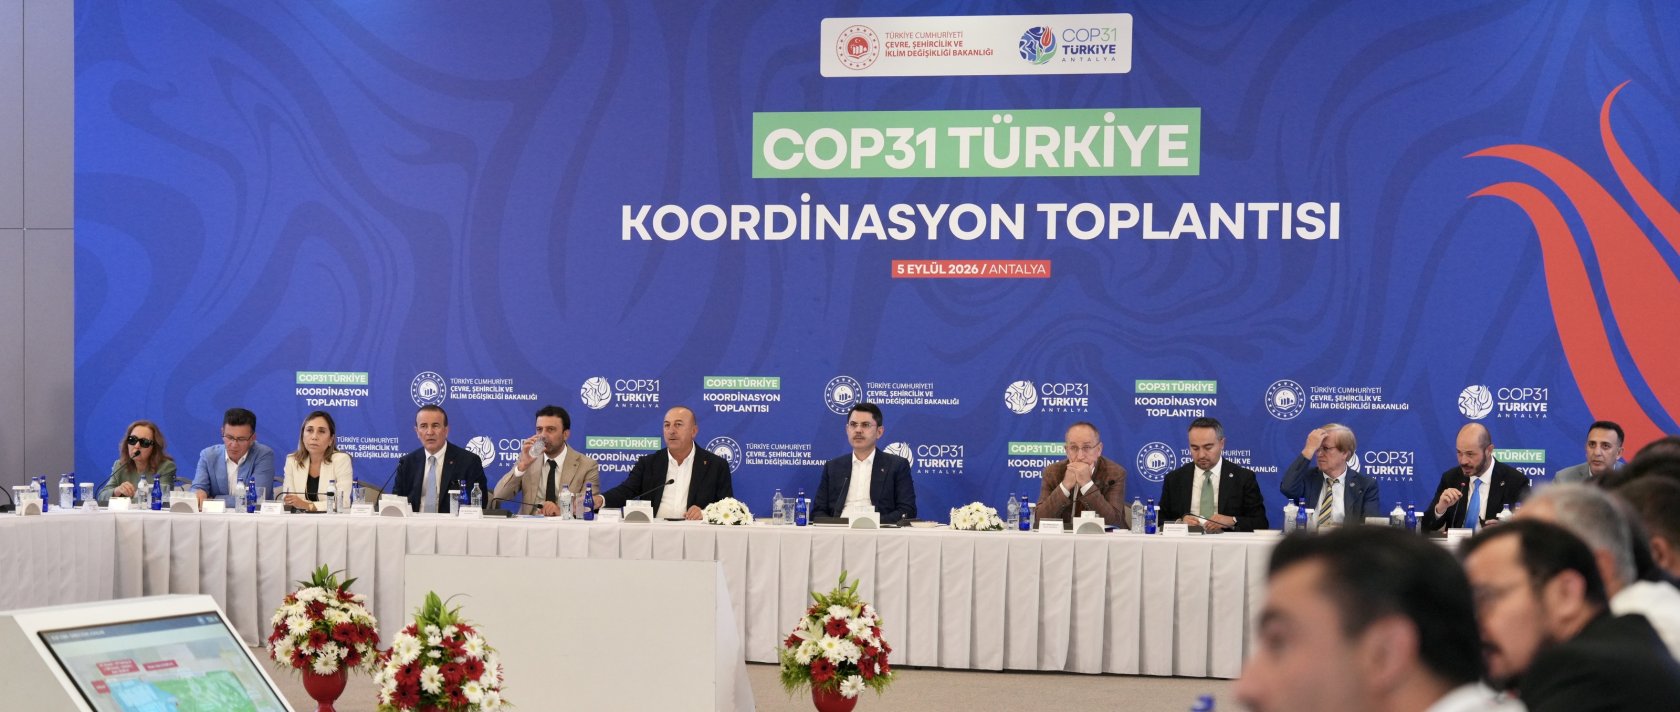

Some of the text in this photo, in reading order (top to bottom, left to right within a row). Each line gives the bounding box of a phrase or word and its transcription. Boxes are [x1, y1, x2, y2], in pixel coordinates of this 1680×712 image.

[885, 31, 913, 39] TÜRKİYE
[1062, 27, 1117, 42] COP31
[912, 40, 952, 49] ŞEHİRCİLİK
[885, 48, 993, 58] İKLİM DEĞİŞİKLİĞİ BAKANLIĞI
[763, 112, 1189, 170] COP31 TÜRKİYE
[622, 192, 1340, 240] KOORDİNASYON TOPLANTISI
[897, 262, 1046, 275] 5 EYLÜL 2026 / ANTALYA
[299, 373, 366, 382] COP31 TÜRKİYE
[706, 377, 778, 387] COP31 TÜRKİYE
[615, 379, 659, 391] COP31
[1041, 383, 1089, 395] COP31
[1171, 381, 1214, 391] TÜRKİYE
[296, 386, 368, 396] KOORDİNASYON
[703, 391, 780, 401] KOORDİNASYON
[1497, 387, 1548, 400] COP31
[1135, 396, 1217, 406] KOORDİNASYON
[1371, 402, 1408, 410] BAKANLIĞI
[714, 404, 769, 412] TOPLANTISI
[1146, 409, 1205, 417] TOPLANTISI
[589, 437, 658, 447] COP31 TÜRKİYE
[917, 445, 963, 457] COP31
[1011, 445, 1043, 453] COP31
[1364, 451, 1414, 464] COP31
[1498, 450, 1542, 460] TÜRKİYE
